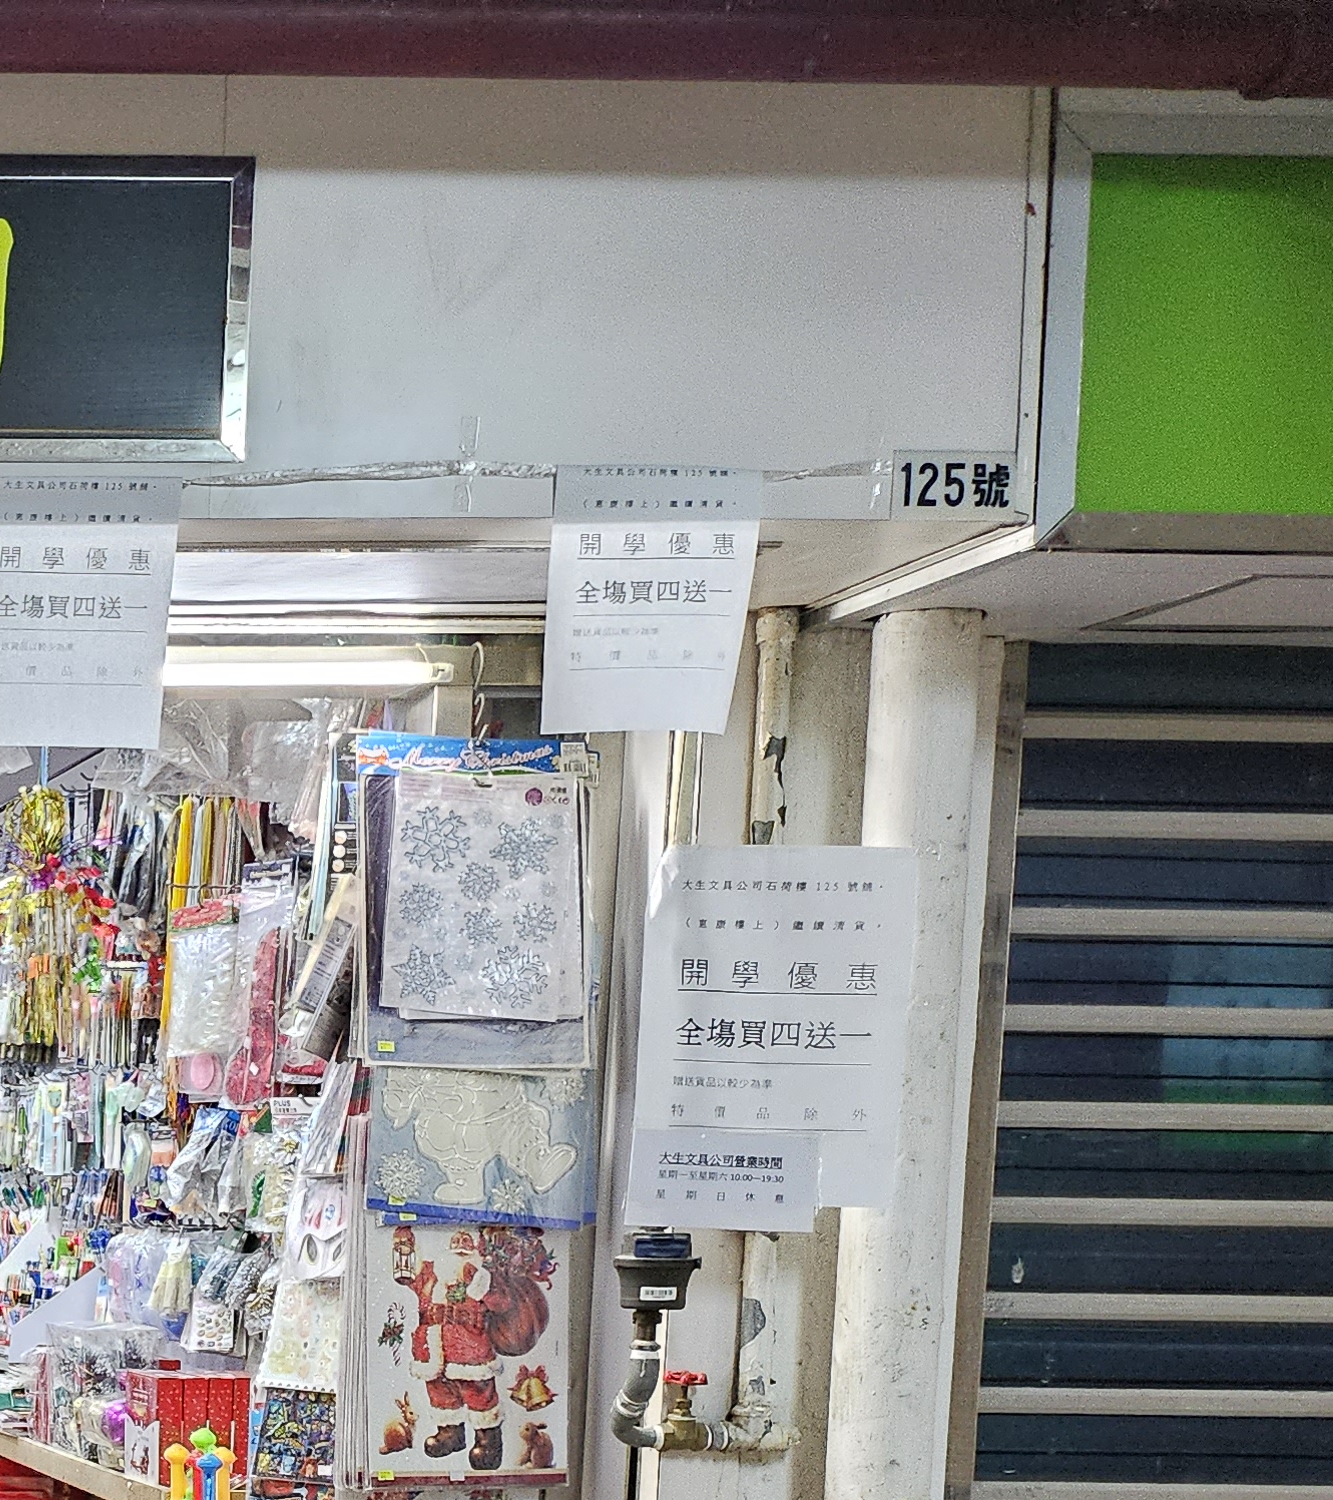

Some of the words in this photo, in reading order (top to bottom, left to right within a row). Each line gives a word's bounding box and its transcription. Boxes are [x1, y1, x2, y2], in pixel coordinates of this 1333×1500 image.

[899, 462, 1012, 511] 125號
[580, 532, 735, 555] 開學優惠
[0, 546, 151, 570] 開學優惠
[816, 881, 839, 892] 125
[680, 958, 878, 990] 開學優惠
